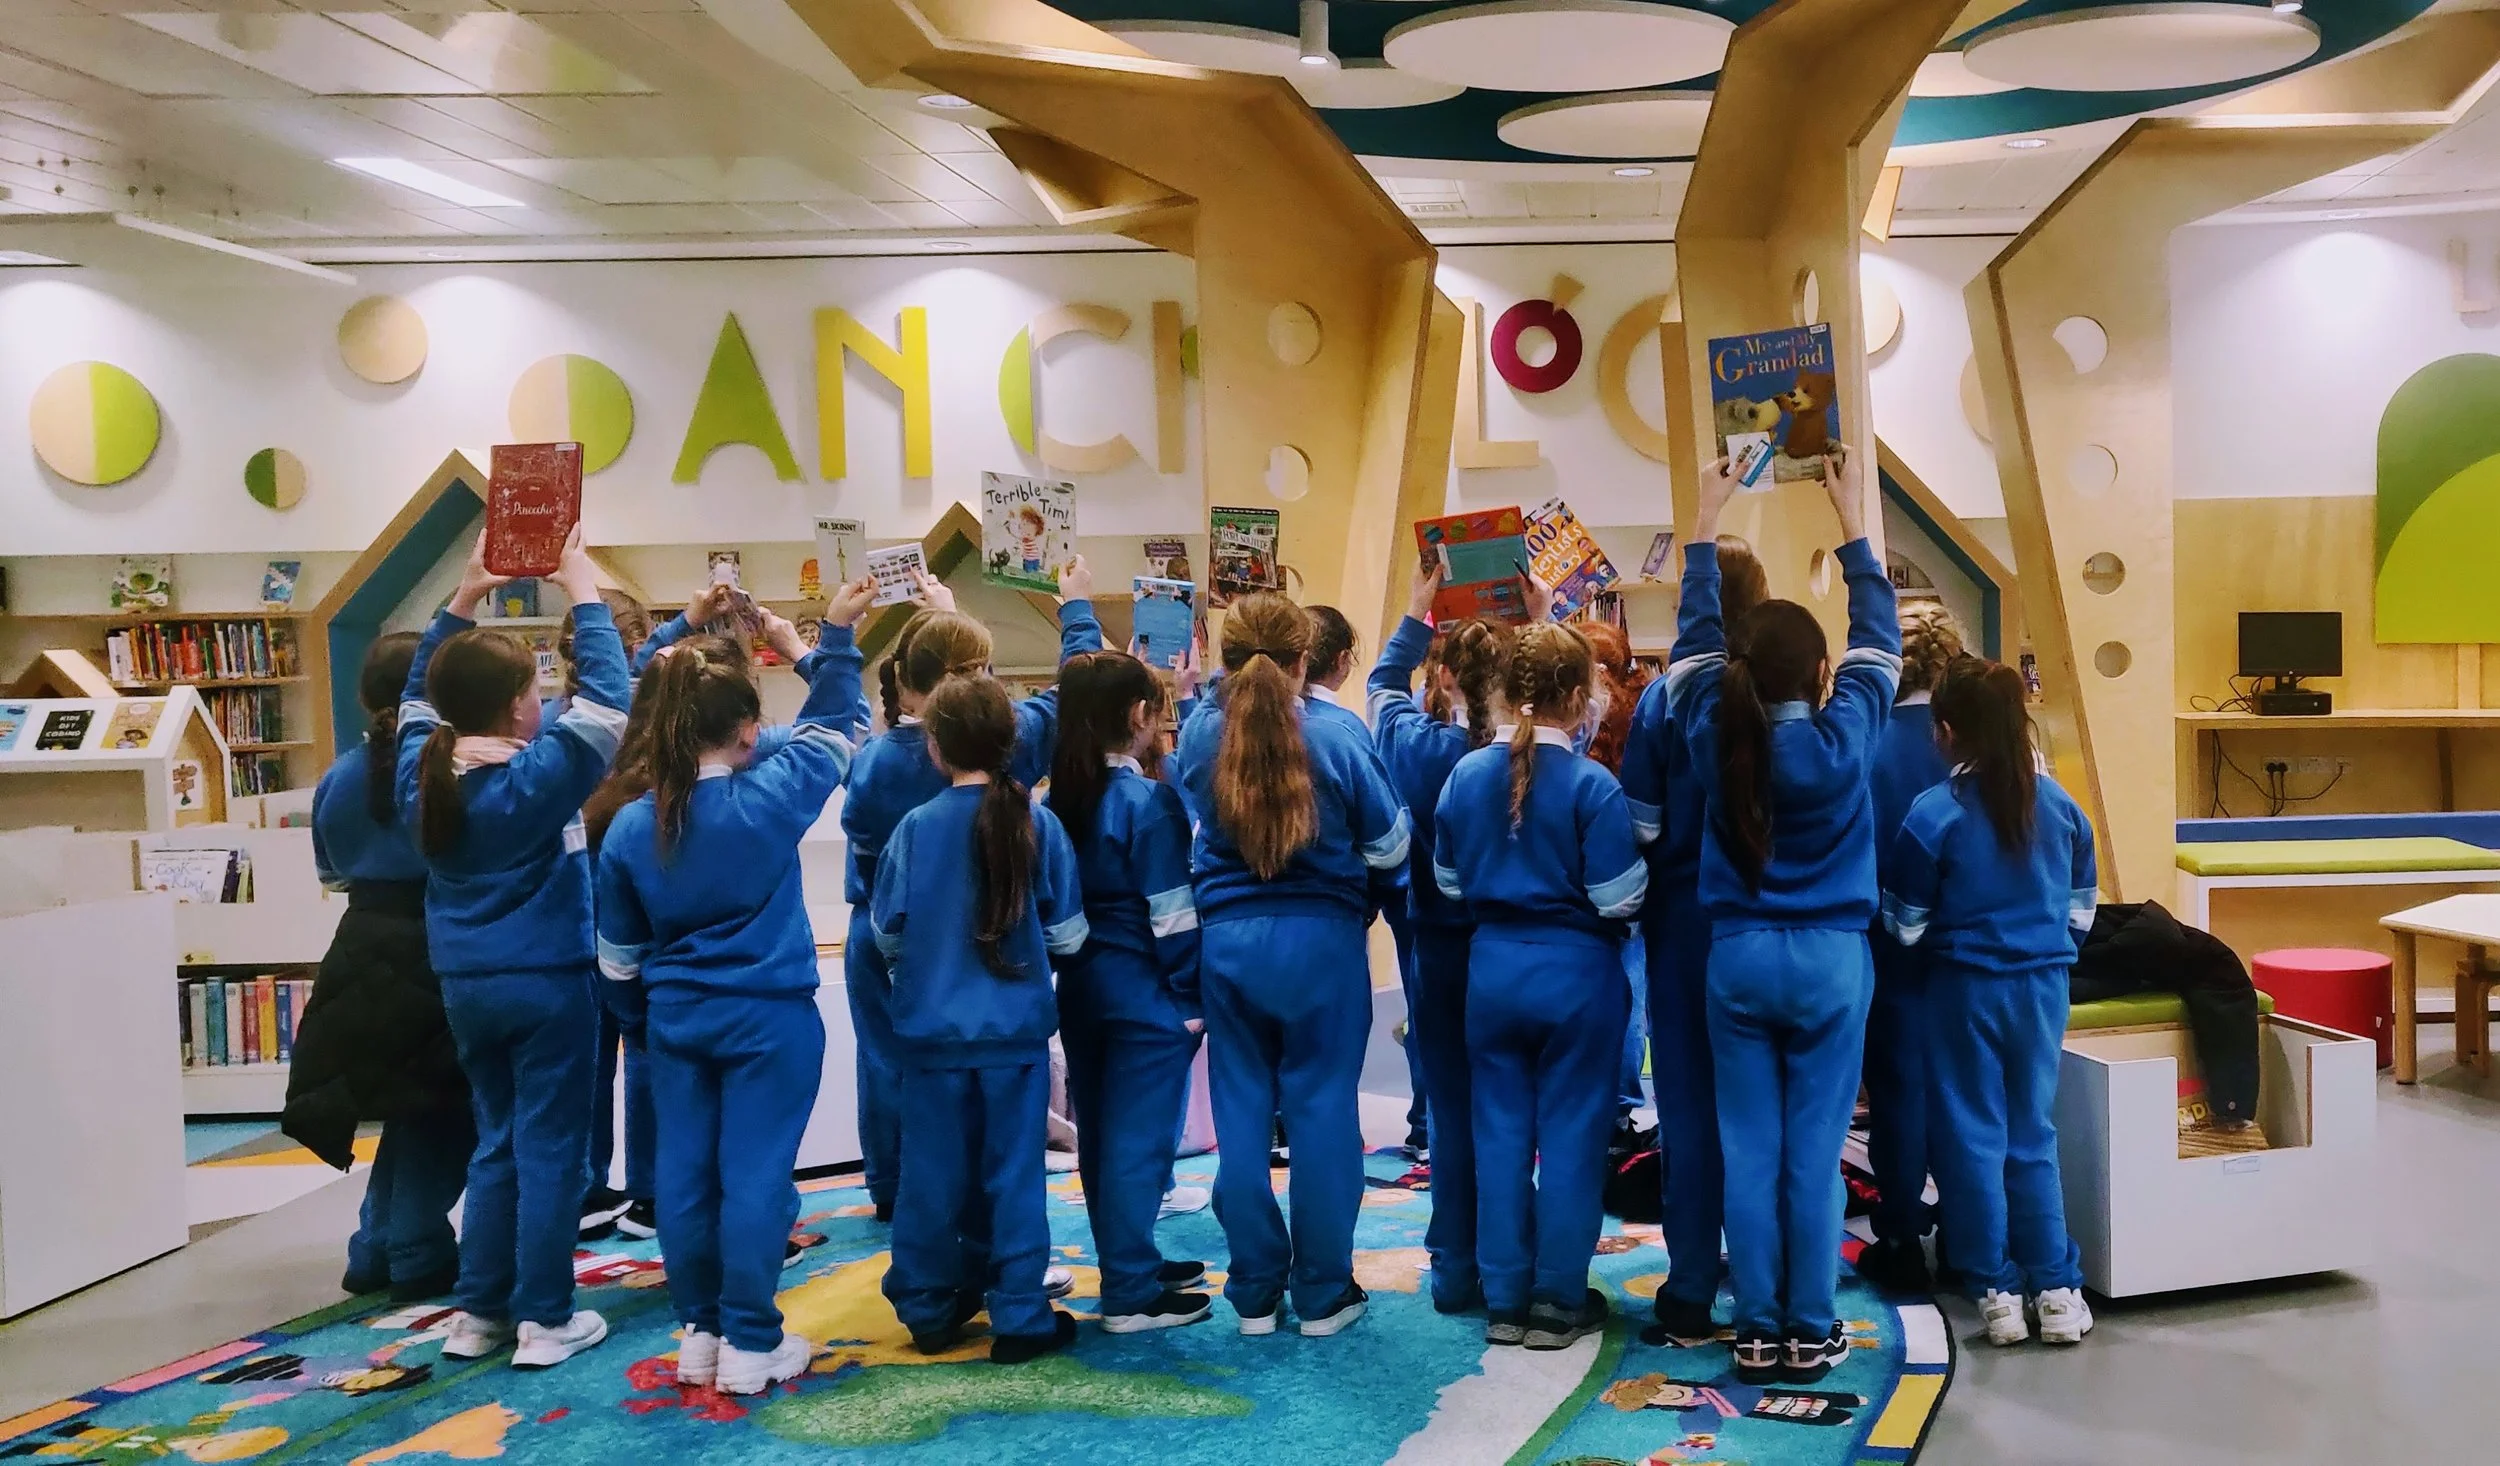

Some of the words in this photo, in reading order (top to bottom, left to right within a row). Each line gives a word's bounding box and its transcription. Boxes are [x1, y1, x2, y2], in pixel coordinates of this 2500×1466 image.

[1744, 337, 1772, 356] Me
[1775, 336, 1795, 350] and
[1714, 343, 1824, 384] Grandad
[672, 306, 934, 483] AN
[985, 481, 1041, 505] Terrible
[511, 501, 555, 516] Pinocchio
[1039, 498, 1070, 523] Tim!
[831, 522, 857, 531] SKINNY
